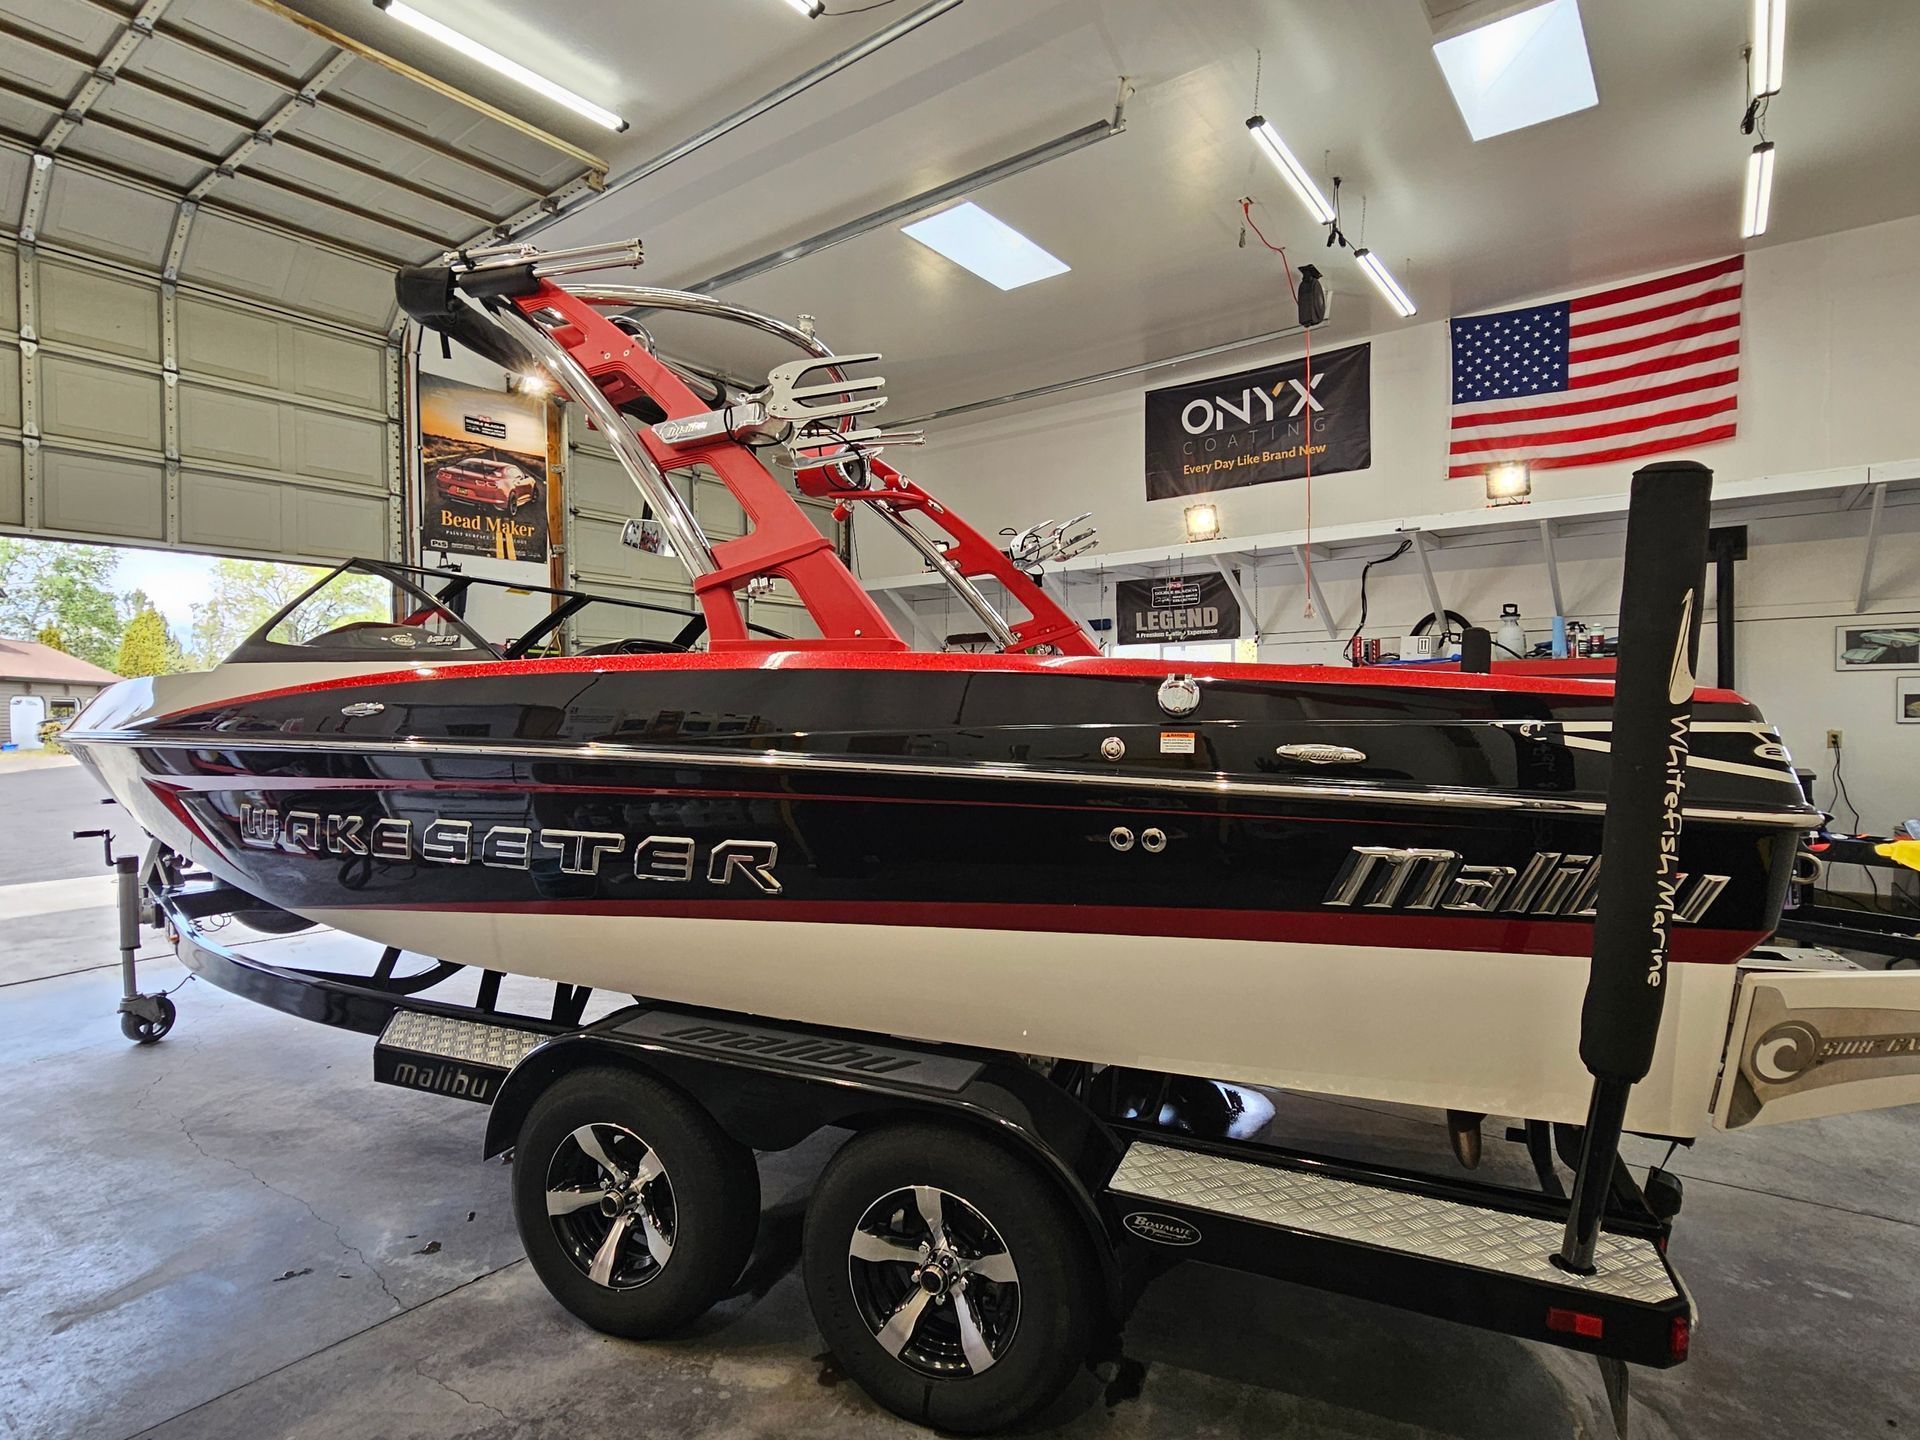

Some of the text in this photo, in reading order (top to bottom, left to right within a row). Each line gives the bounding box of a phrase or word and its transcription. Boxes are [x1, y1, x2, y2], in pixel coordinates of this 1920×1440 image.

[1181, 373, 1325, 435] ONYX
[1183, 417, 1326, 455] COATING
[1183, 444, 1327, 475] Every Day Like Brand New
[441, 510, 535, 537] Bead Maker
[1136, 606, 1219, 631] LEGEND
[1647, 714, 1691, 988] Whitefish Marine
[660, 1025, 923, 1074] malibu
[392, 1062, 489, 1099] malibu
